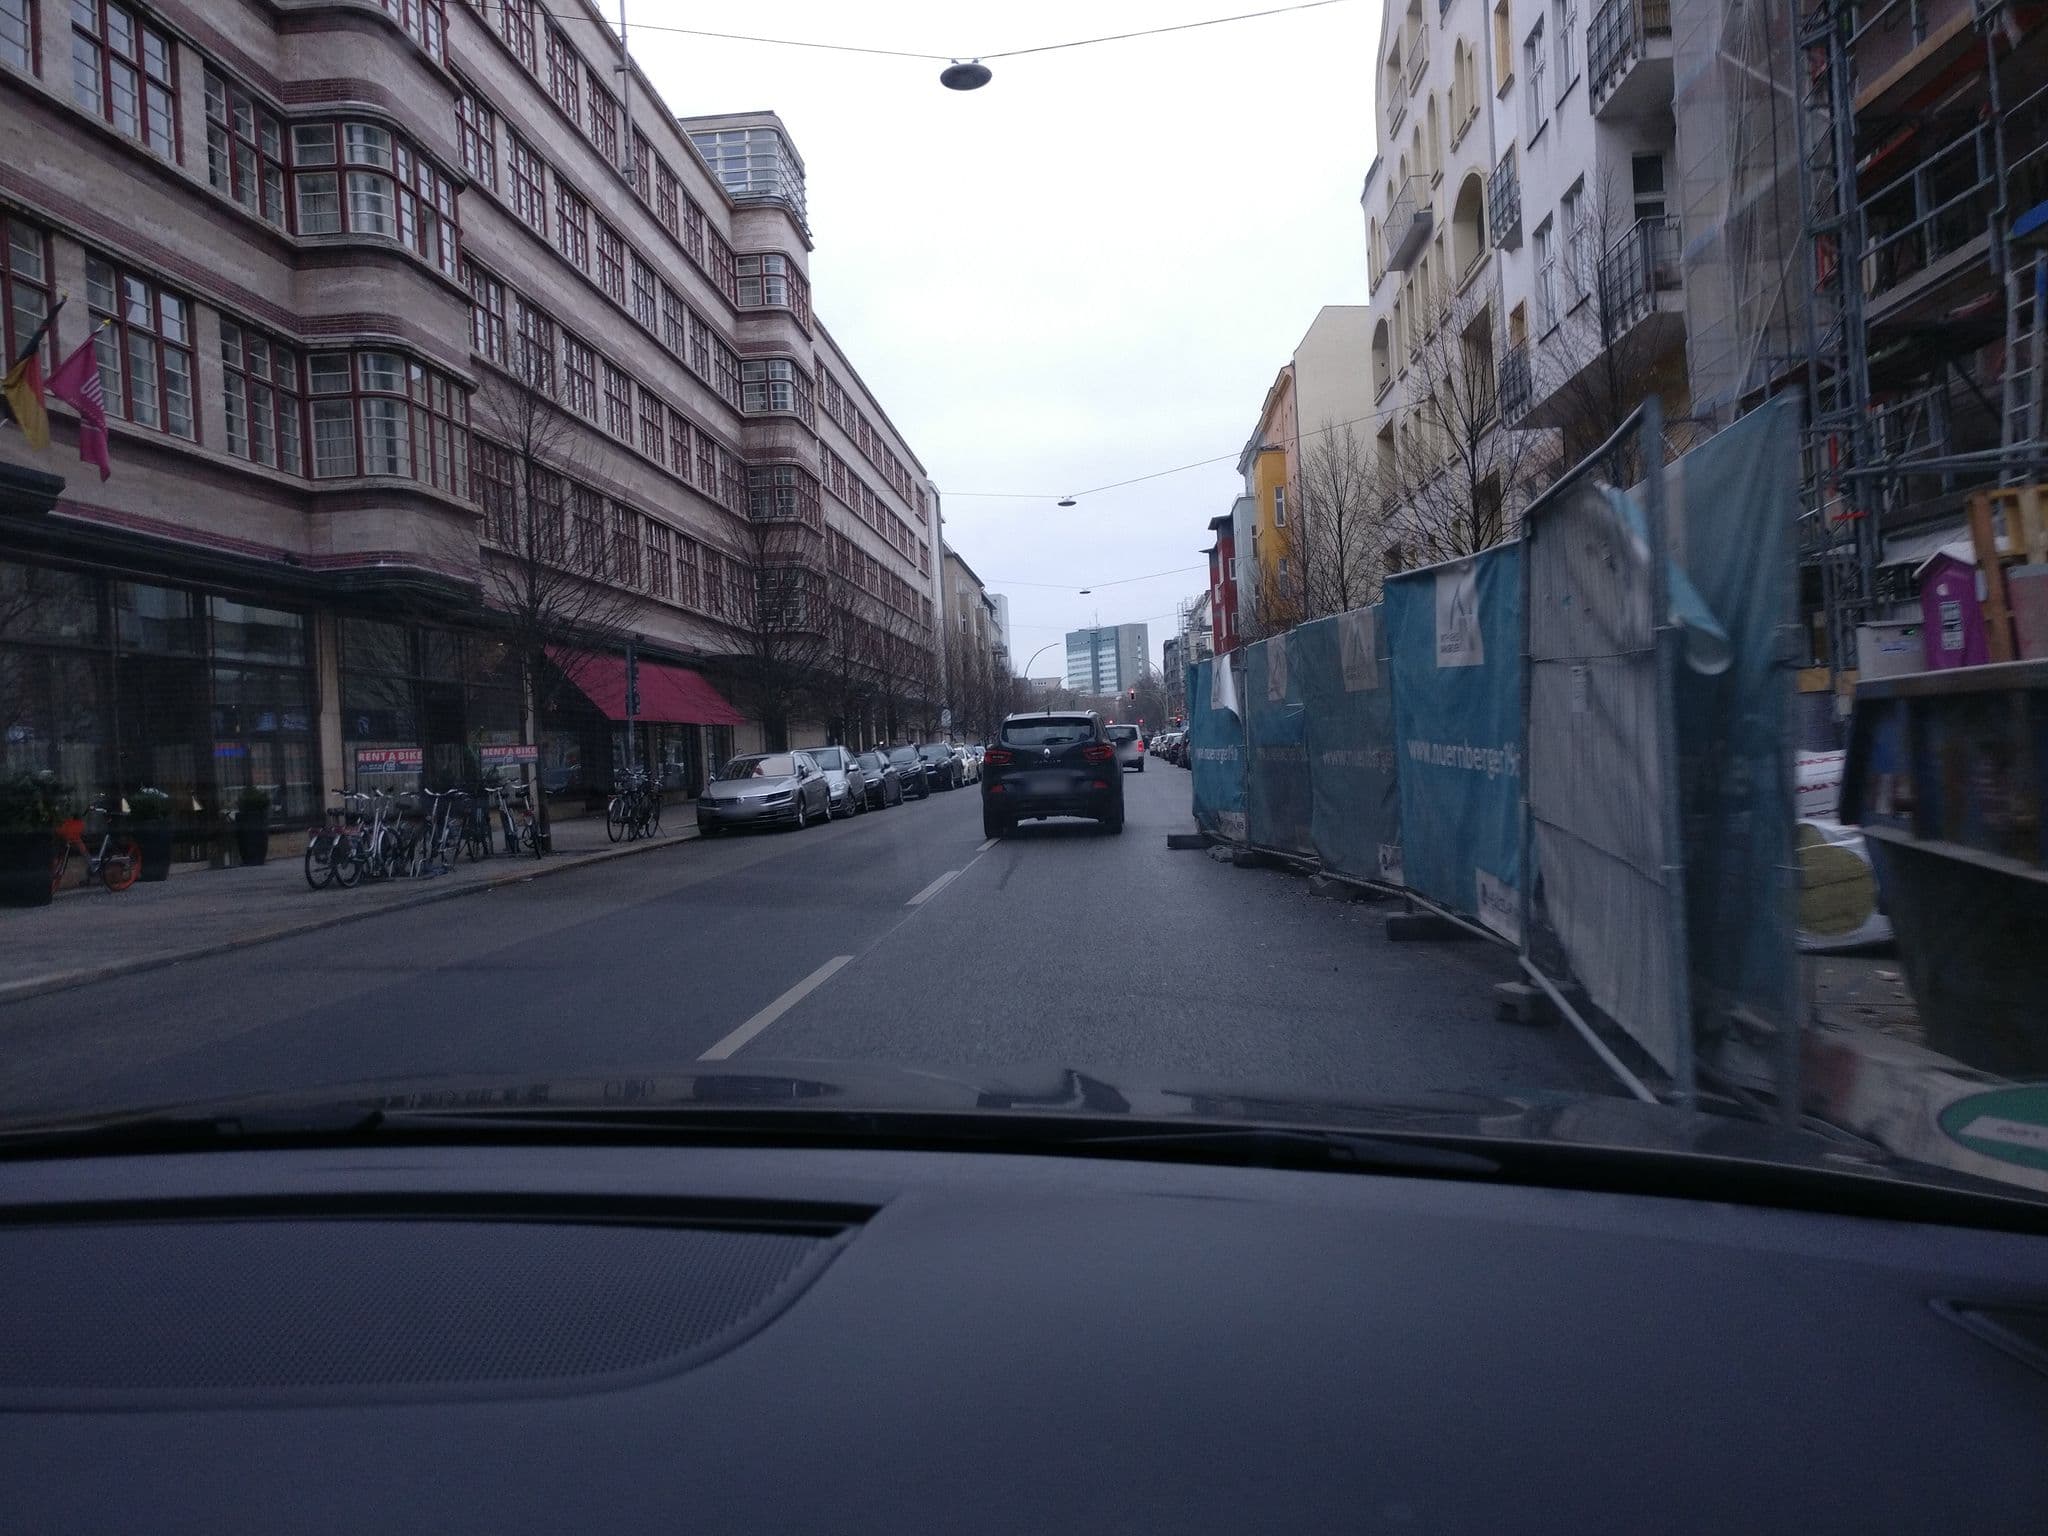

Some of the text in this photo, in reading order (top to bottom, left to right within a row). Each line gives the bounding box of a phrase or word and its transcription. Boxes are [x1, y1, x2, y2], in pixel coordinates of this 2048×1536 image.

[482, 747, 506, 756] RENT
[516, 746, 537, 754] BIKE
[358, 752, 386, 762] RENT
[398, 751, 423, 760] BIKE
